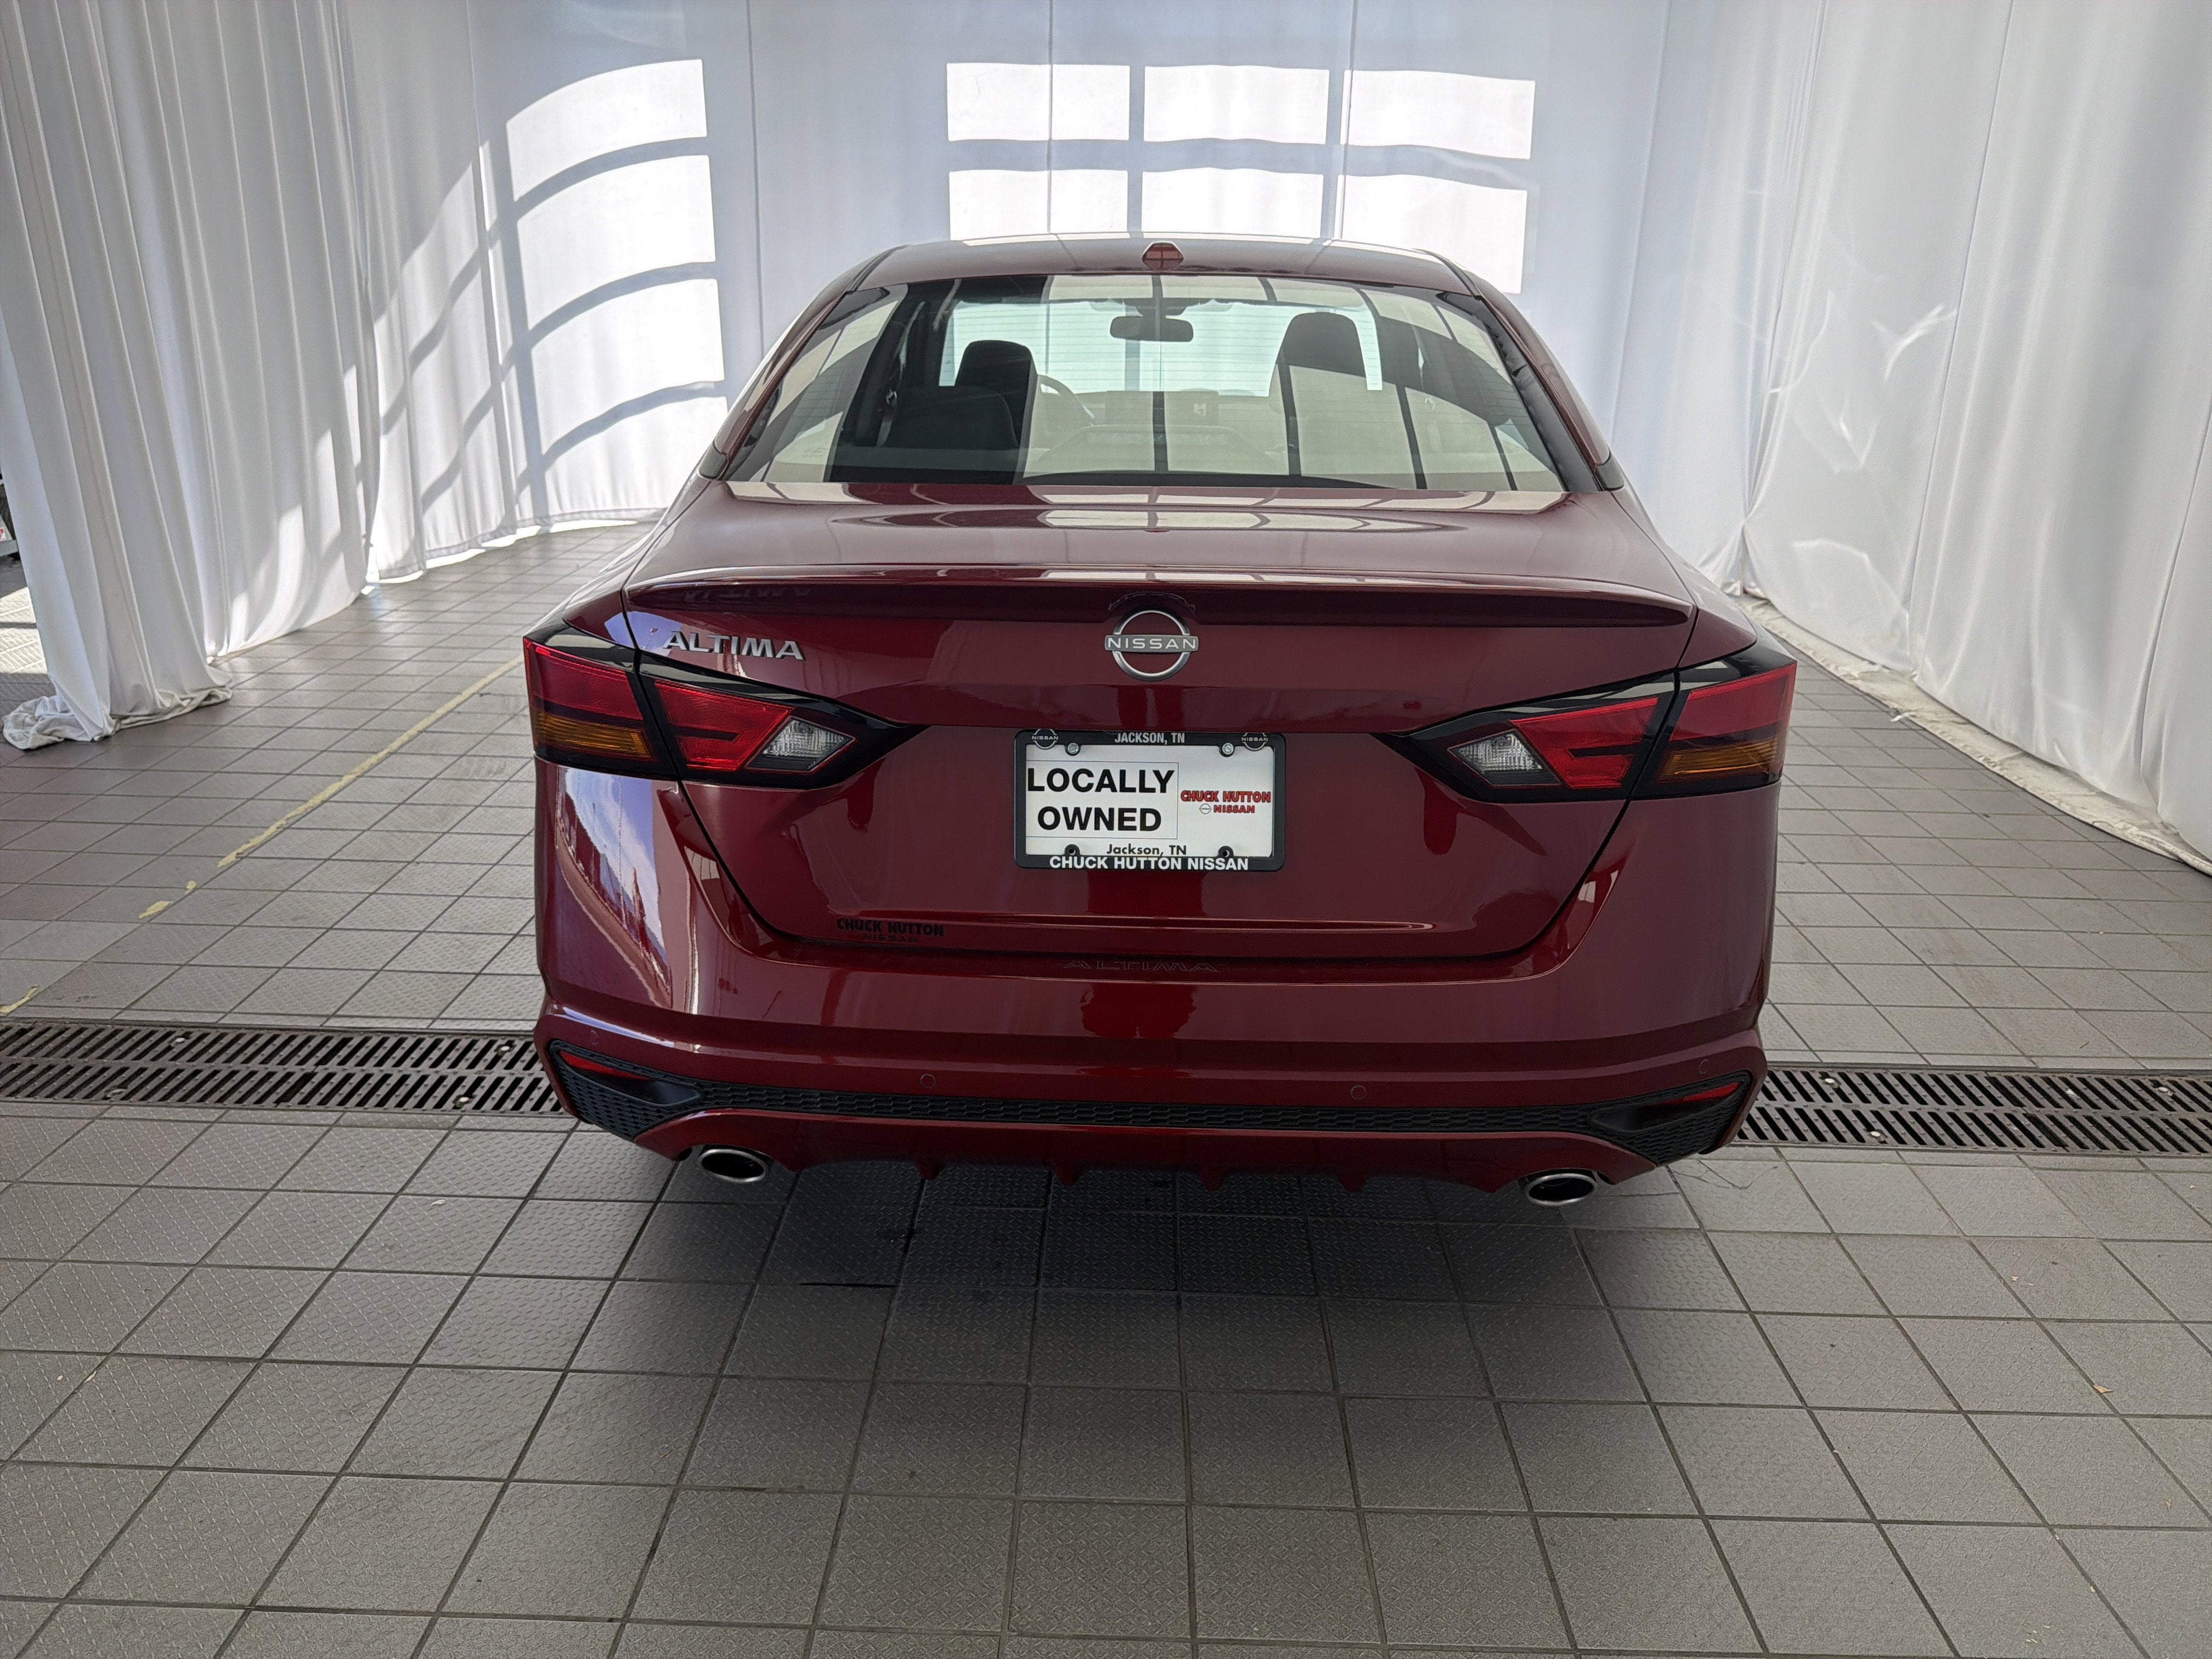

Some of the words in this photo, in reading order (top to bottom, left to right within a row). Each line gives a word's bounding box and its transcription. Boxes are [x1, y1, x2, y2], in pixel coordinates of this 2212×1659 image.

[662, 631, 805, 660] ALTIMA
[1108, 637, 1195, 649] NISSAN
[1114, 732, 1168, 745] JACKSON,
[1170, 732, 1185, 743] TN
[1027, 768, 1175, 793] LOCALLY
[1180, 790, 1219, 802] CHUCK
[1222, 791, 1271, 803] HUTTON
[1214, 805, 1255, 814] NISSAN
[1037, 806, 1162, 831] OWNED
[1106, 844, 1164, 856] Jackson,
[1169, 845, 1187, 855] TN
[1049, 856, 1108, 870] CHUCK
[1114, 856, 1182, 870] HUTTON
[1187, 857, 1248, 871] NISSAN
[836, 918, 883, 932] CHUCK
[887, 921, 944, 936] HUTTON
[1063, 960, 1218, 973] ALTIMA
